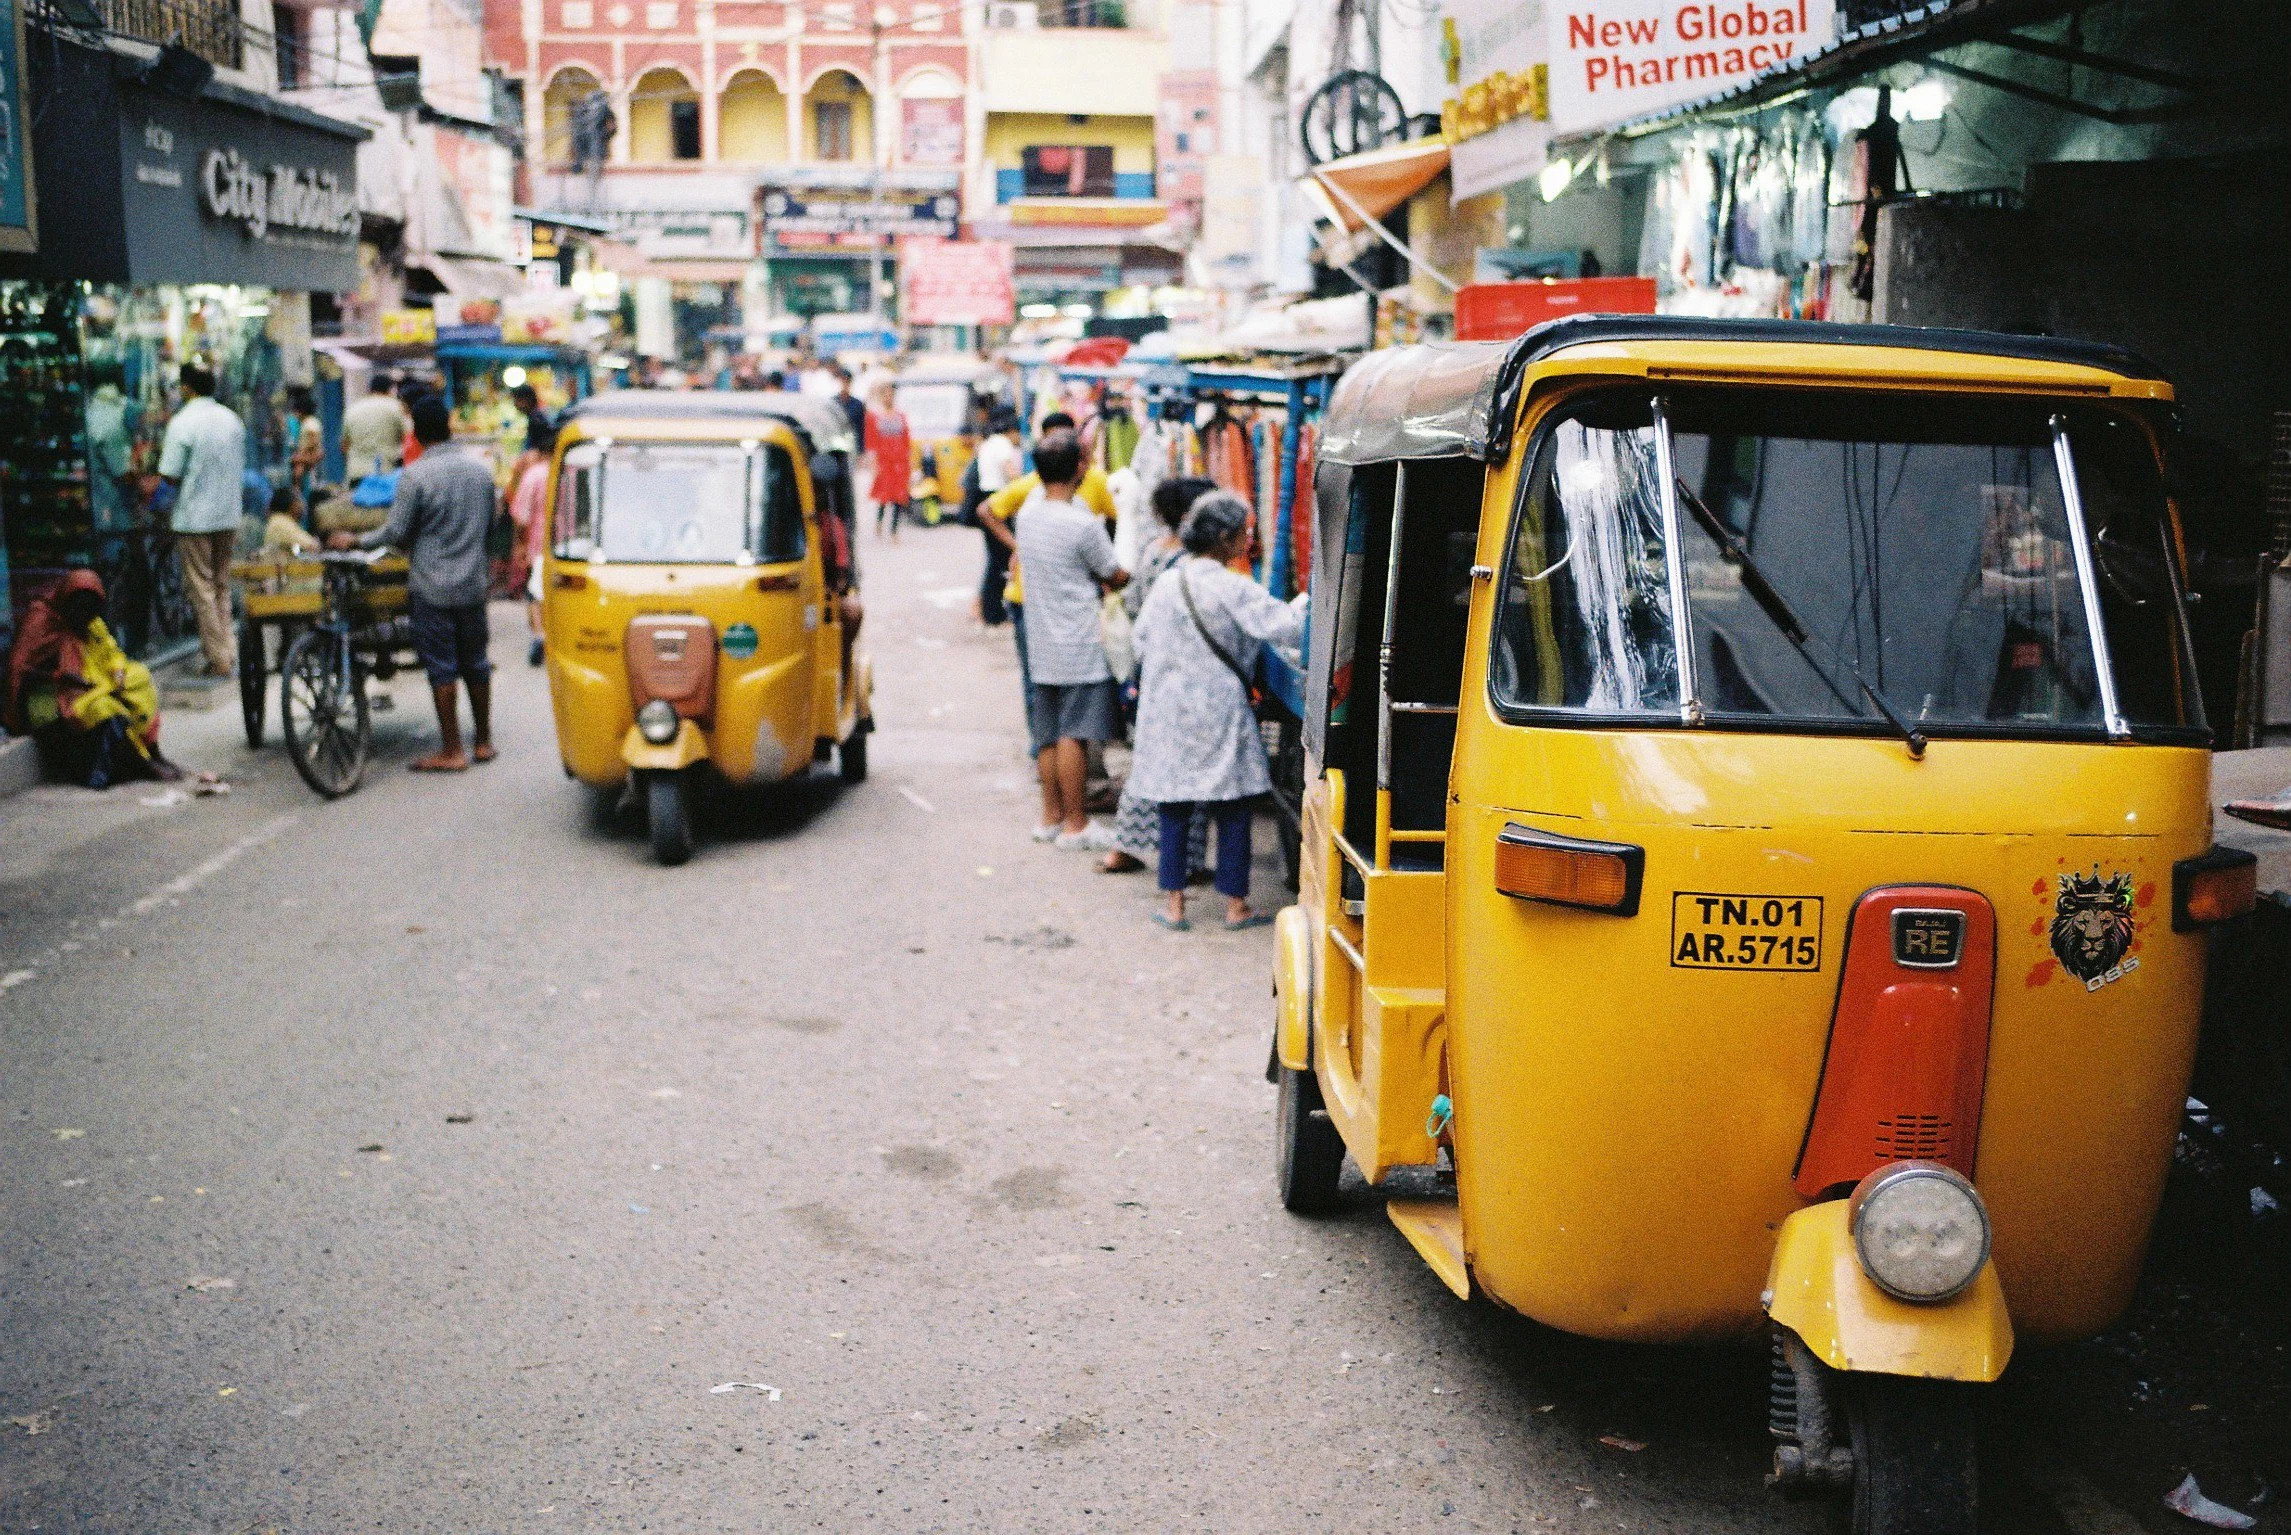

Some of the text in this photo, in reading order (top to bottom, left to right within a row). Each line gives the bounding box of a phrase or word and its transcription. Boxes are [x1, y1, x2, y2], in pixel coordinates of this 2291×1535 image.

[1568, 14, 1660, 50] New
[1675, 0, 1808, 42] Global
[1584, 41, 1794, 93] Pharmacy
[205, 147, 268, 239] City
[1695, 897, 1803, 927] TN.01
[1676, 932, 1816, 966] AR.5715
[1905, 929, 1951, 955] RE
